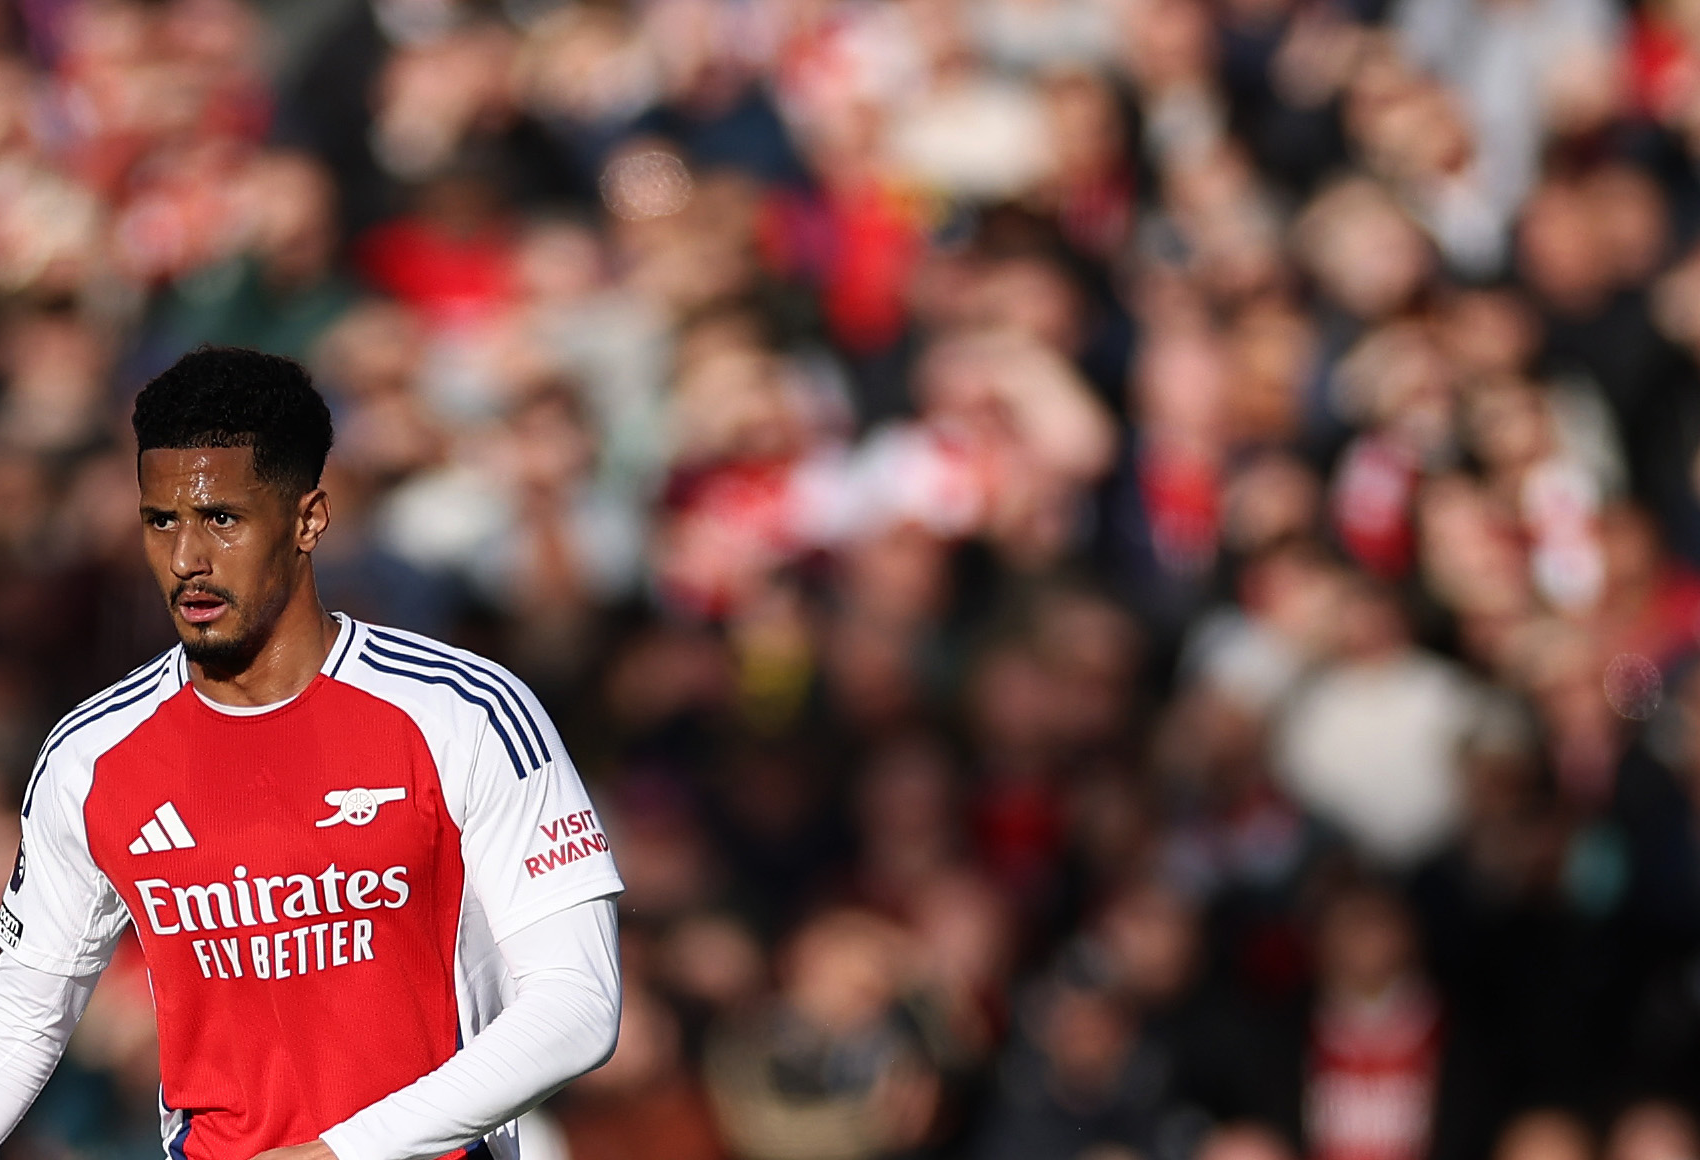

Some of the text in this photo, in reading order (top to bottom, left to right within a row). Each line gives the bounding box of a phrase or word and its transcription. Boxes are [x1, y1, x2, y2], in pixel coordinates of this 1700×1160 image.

[539, 809, 595, 842] VISIT
[134, 863, 409, 935] Emirates
[192, 919, 374, 979] FLY BETTER
